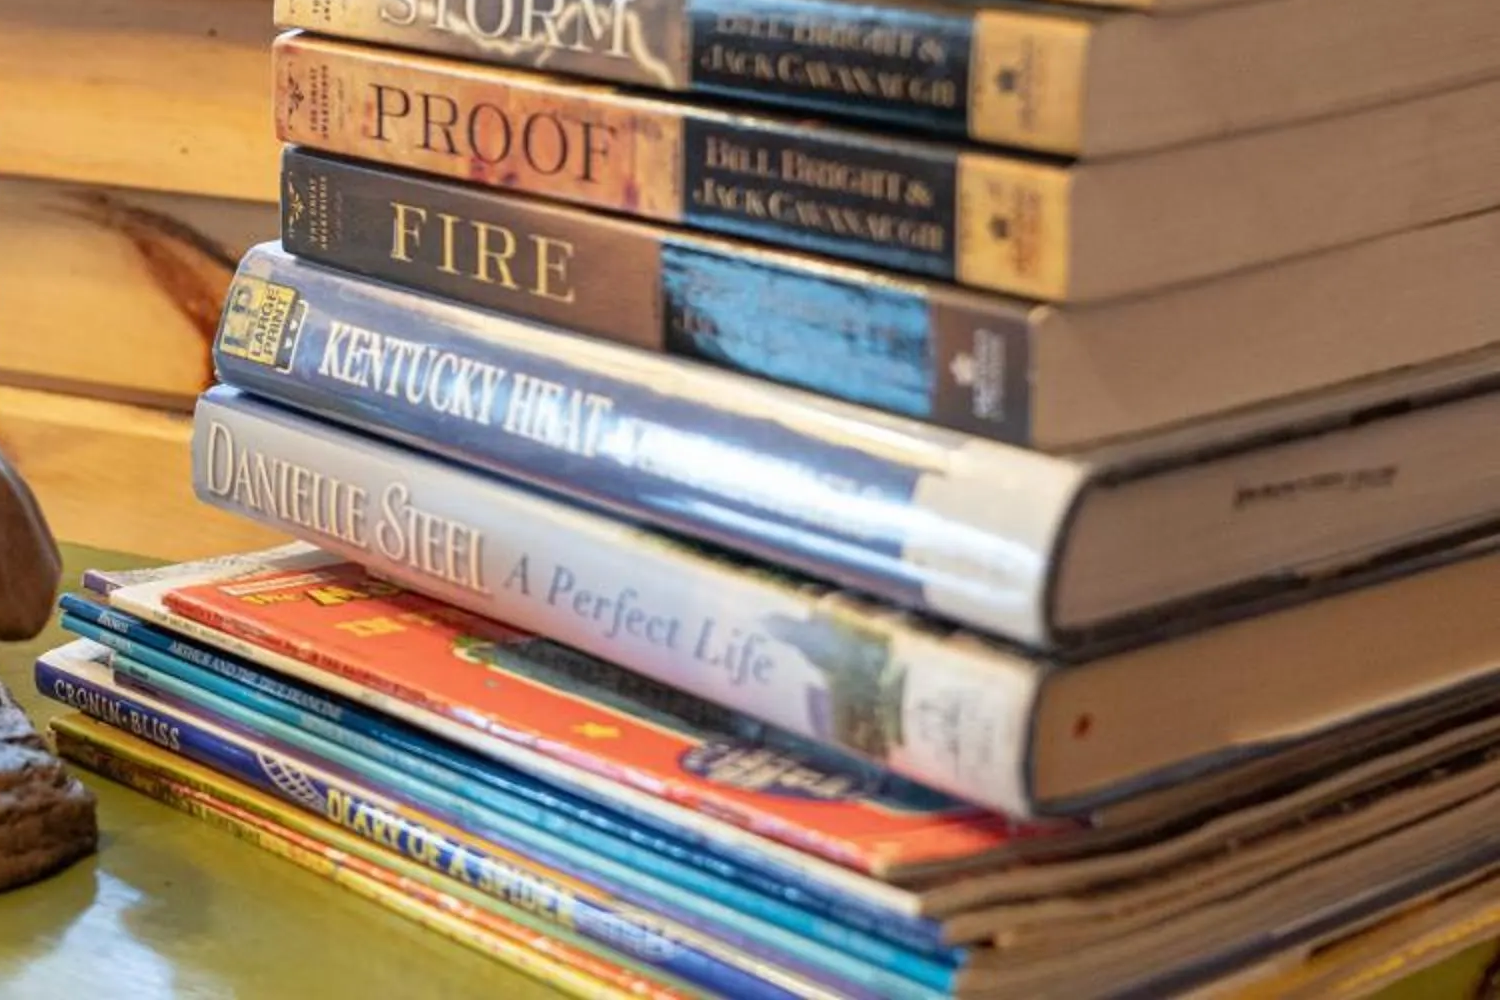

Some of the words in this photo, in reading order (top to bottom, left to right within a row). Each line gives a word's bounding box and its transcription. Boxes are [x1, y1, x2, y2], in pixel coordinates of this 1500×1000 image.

[368, 82, 619, 184] PROOF
[390, 200, 577, 303] FIRE
[250, 284, 281, 357] LARGE
[262, 292, 291, 362] PRINT
[319, 321, 506, 427] KENTUCKY
[206, 421, 370, 549] DANIELLE
[375, 481, 494, 598] STEEL
[505, 553, 532, 597] A
[546, 564, 682, 649] Perfect
[693, 616, 776, 687] Life
[326, 787, 403, 850] DIARY
[406, 823, 441, 866] OF
[448, 844, 472, 884] A
